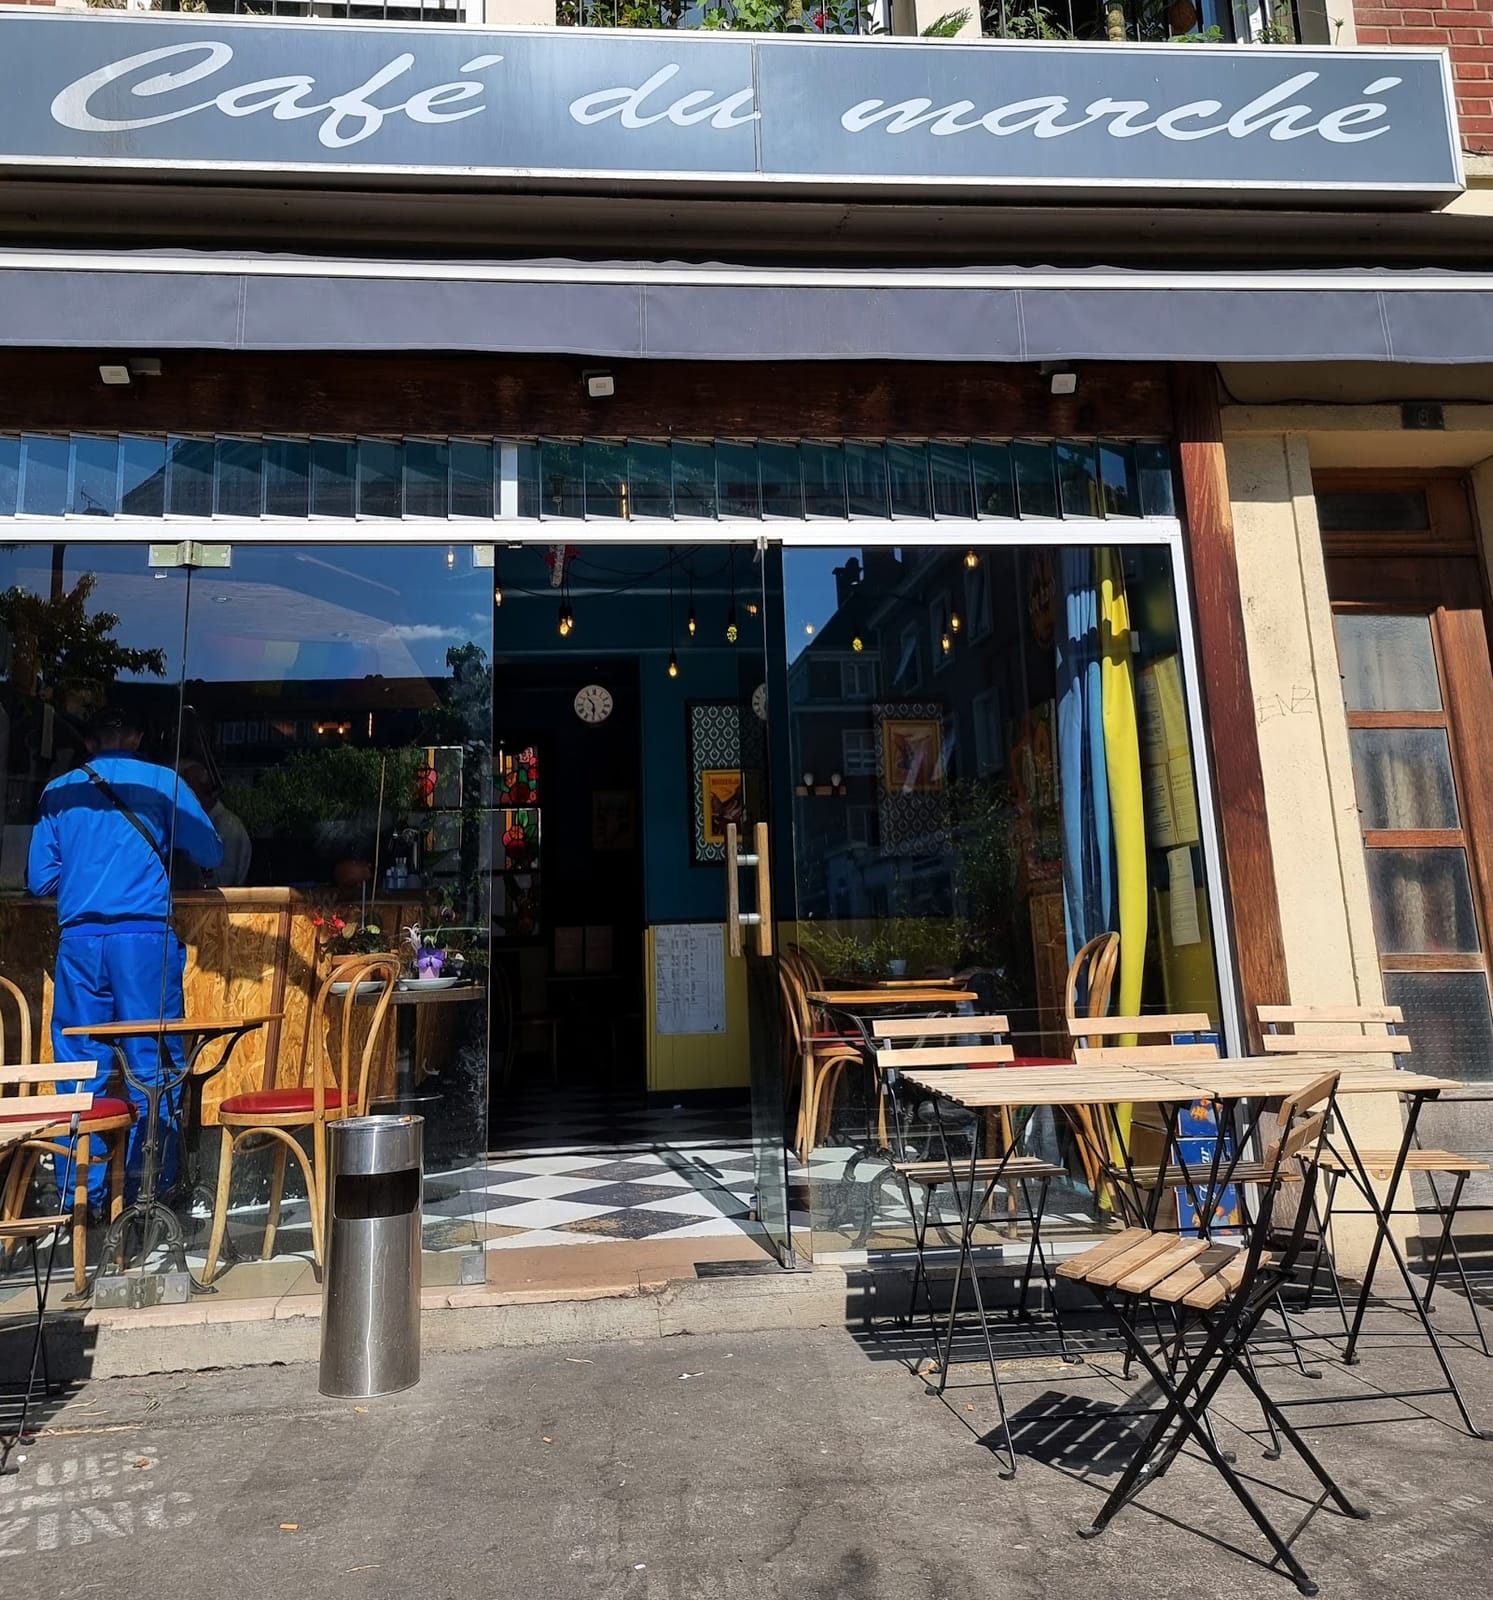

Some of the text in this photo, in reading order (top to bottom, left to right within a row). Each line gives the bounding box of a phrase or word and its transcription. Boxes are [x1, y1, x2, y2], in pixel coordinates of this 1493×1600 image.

[51, 41, 1403, 148] Café du marché
